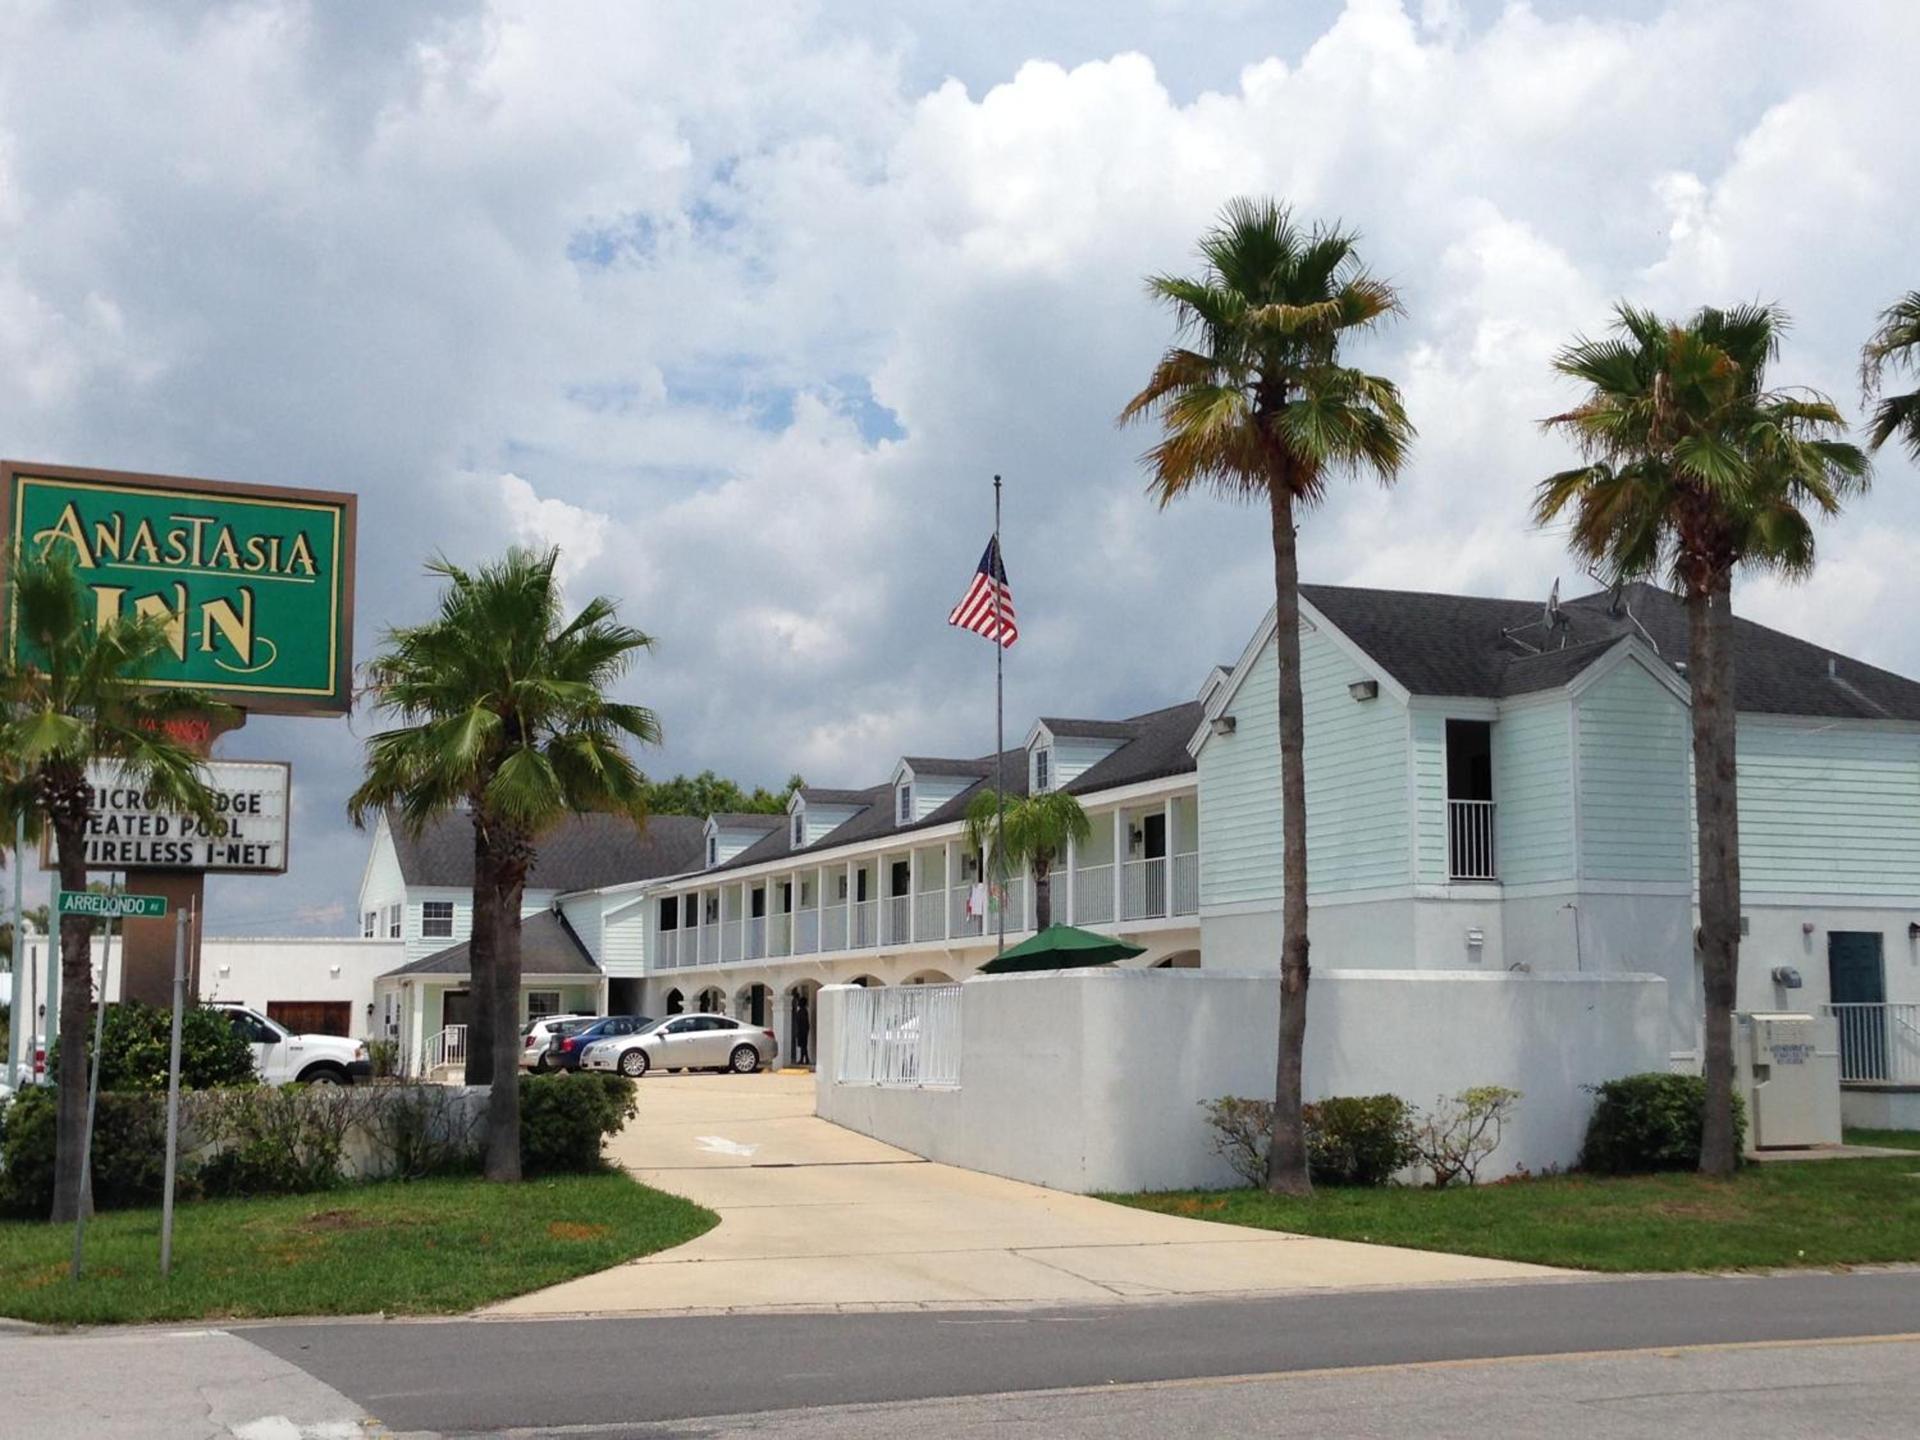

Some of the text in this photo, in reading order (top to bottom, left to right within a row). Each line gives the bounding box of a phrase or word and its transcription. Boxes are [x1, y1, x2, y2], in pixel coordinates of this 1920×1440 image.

[91, 583, 252, 665] INN
[206, 843, 271, 865] I-NET
[64, 895, 146, 914] ARREDONDO
